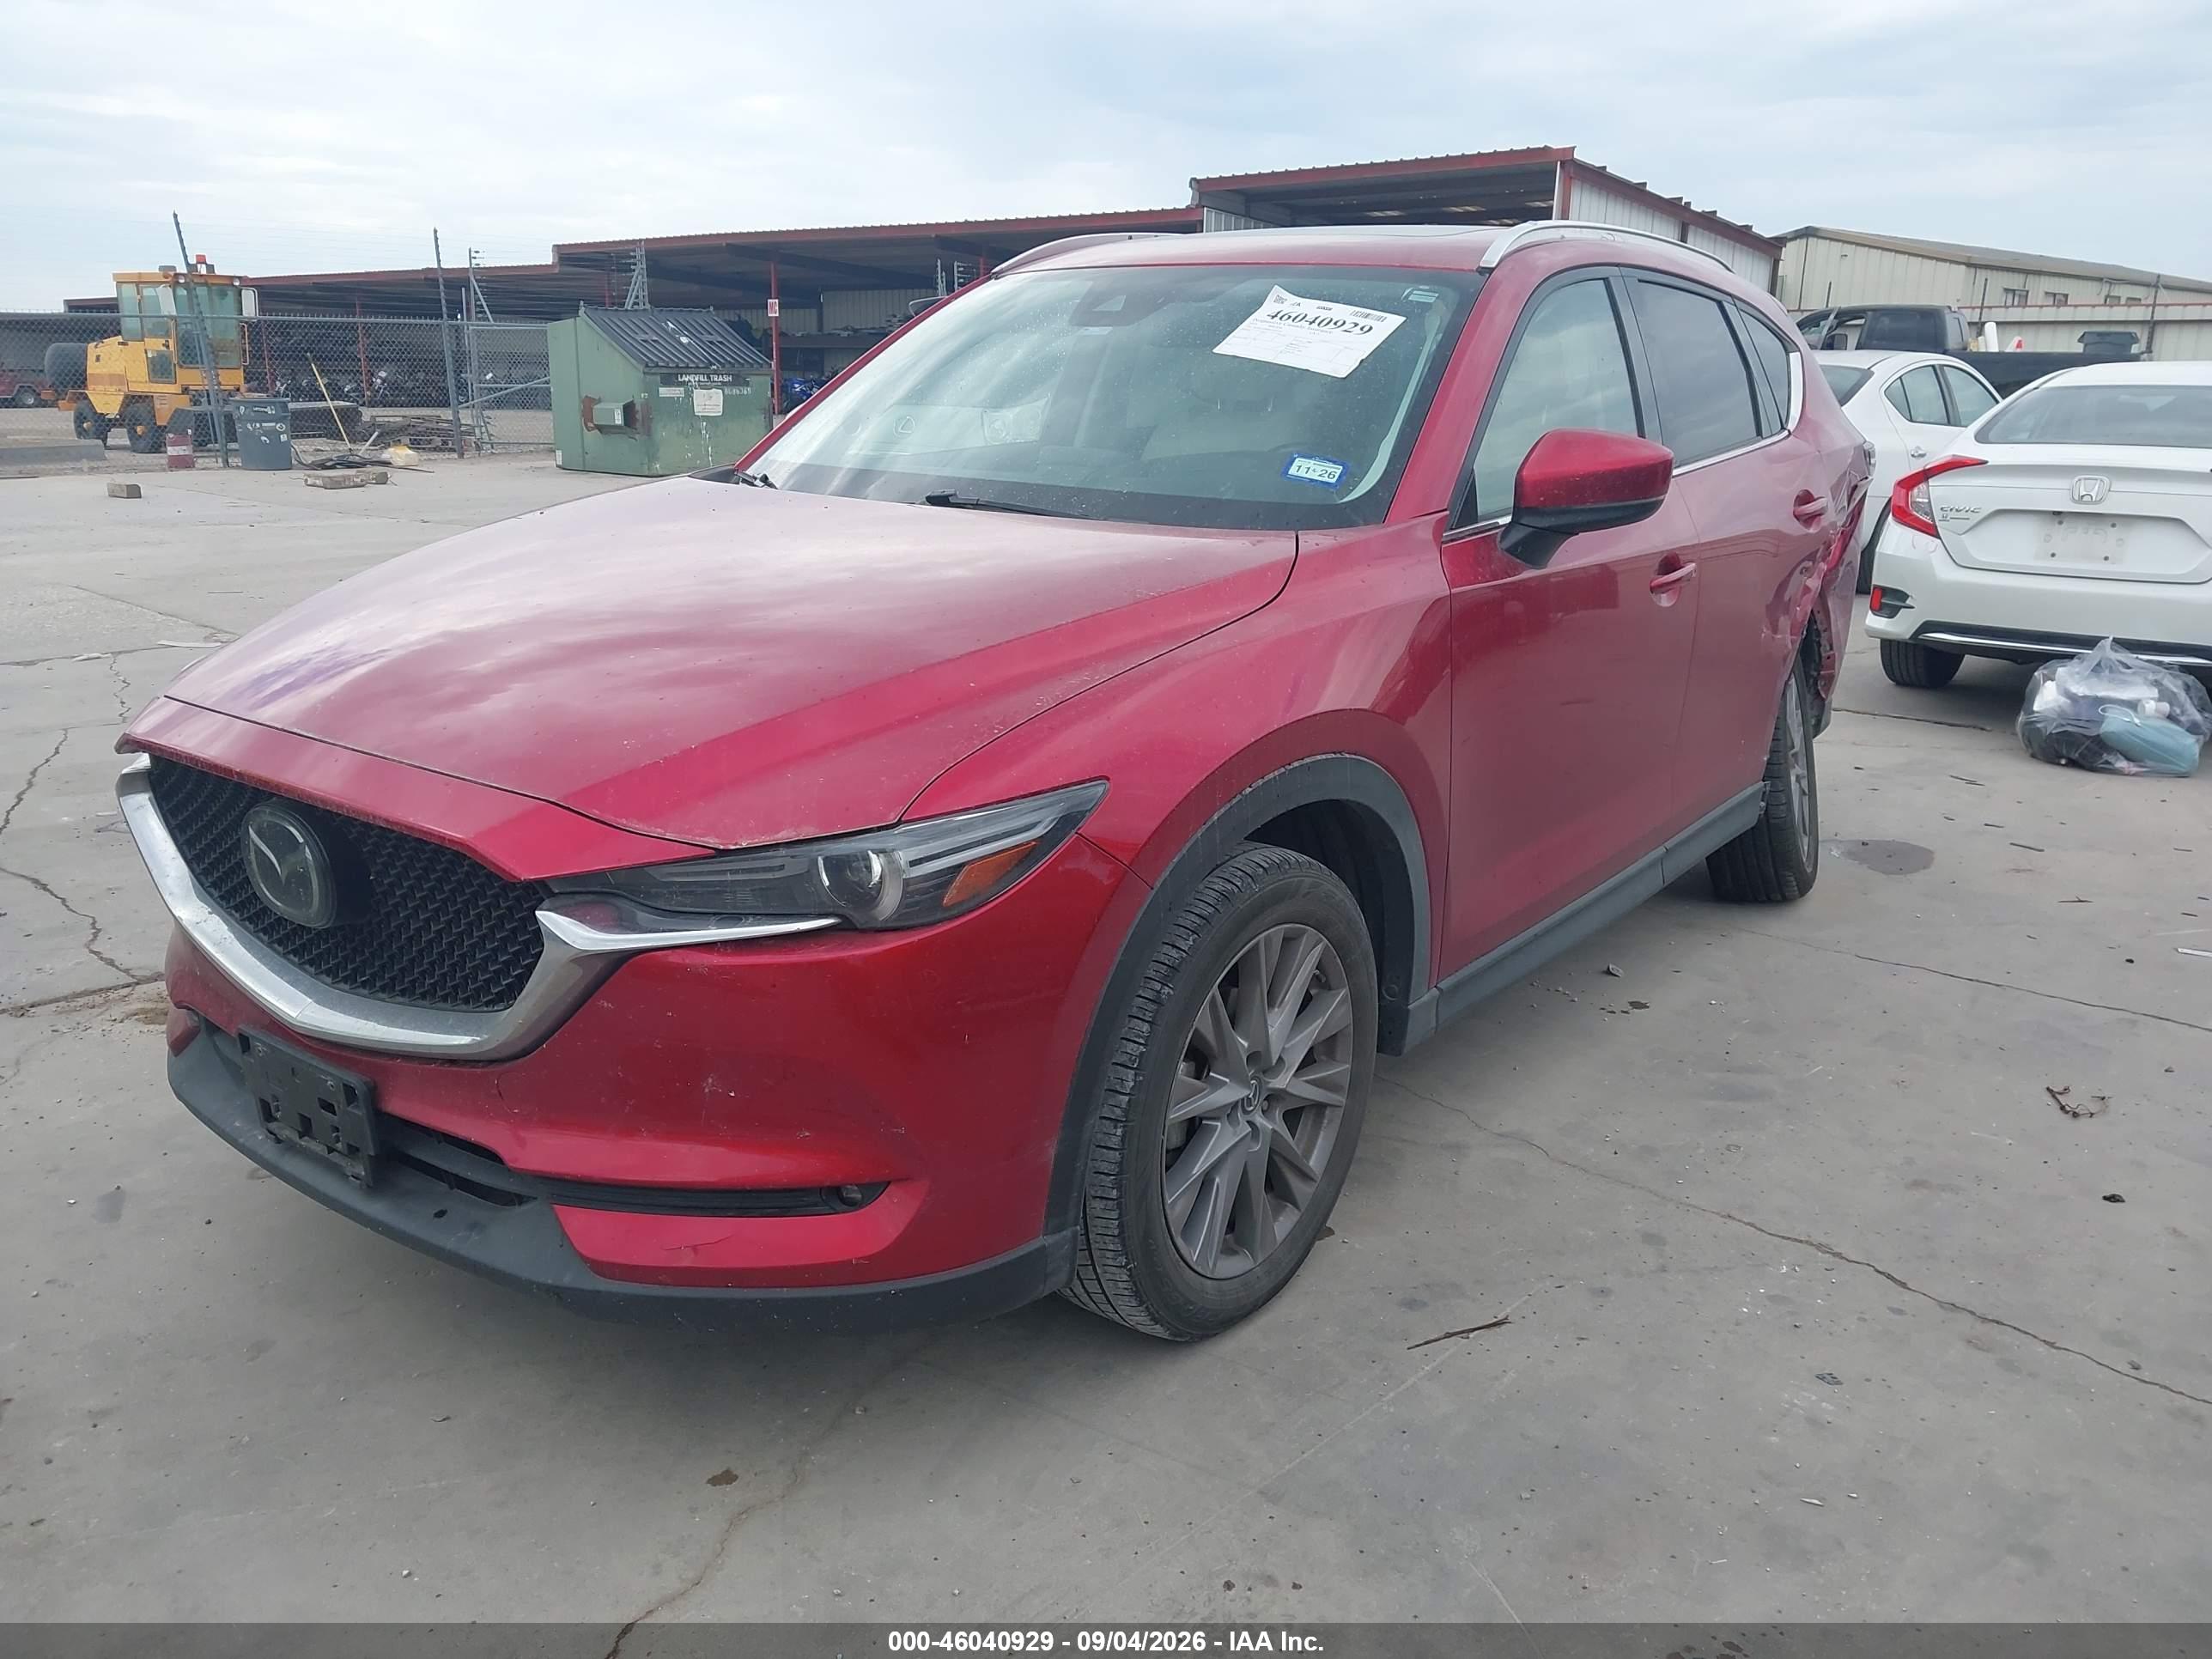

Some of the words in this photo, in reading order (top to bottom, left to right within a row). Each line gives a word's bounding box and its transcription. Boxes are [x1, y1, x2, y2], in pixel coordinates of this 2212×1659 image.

[1267, 309, 1374, 336] 46040929
[678, 374, 708, 382] LANDFILL
[1940, 505, 1982, 514] CIVIC
